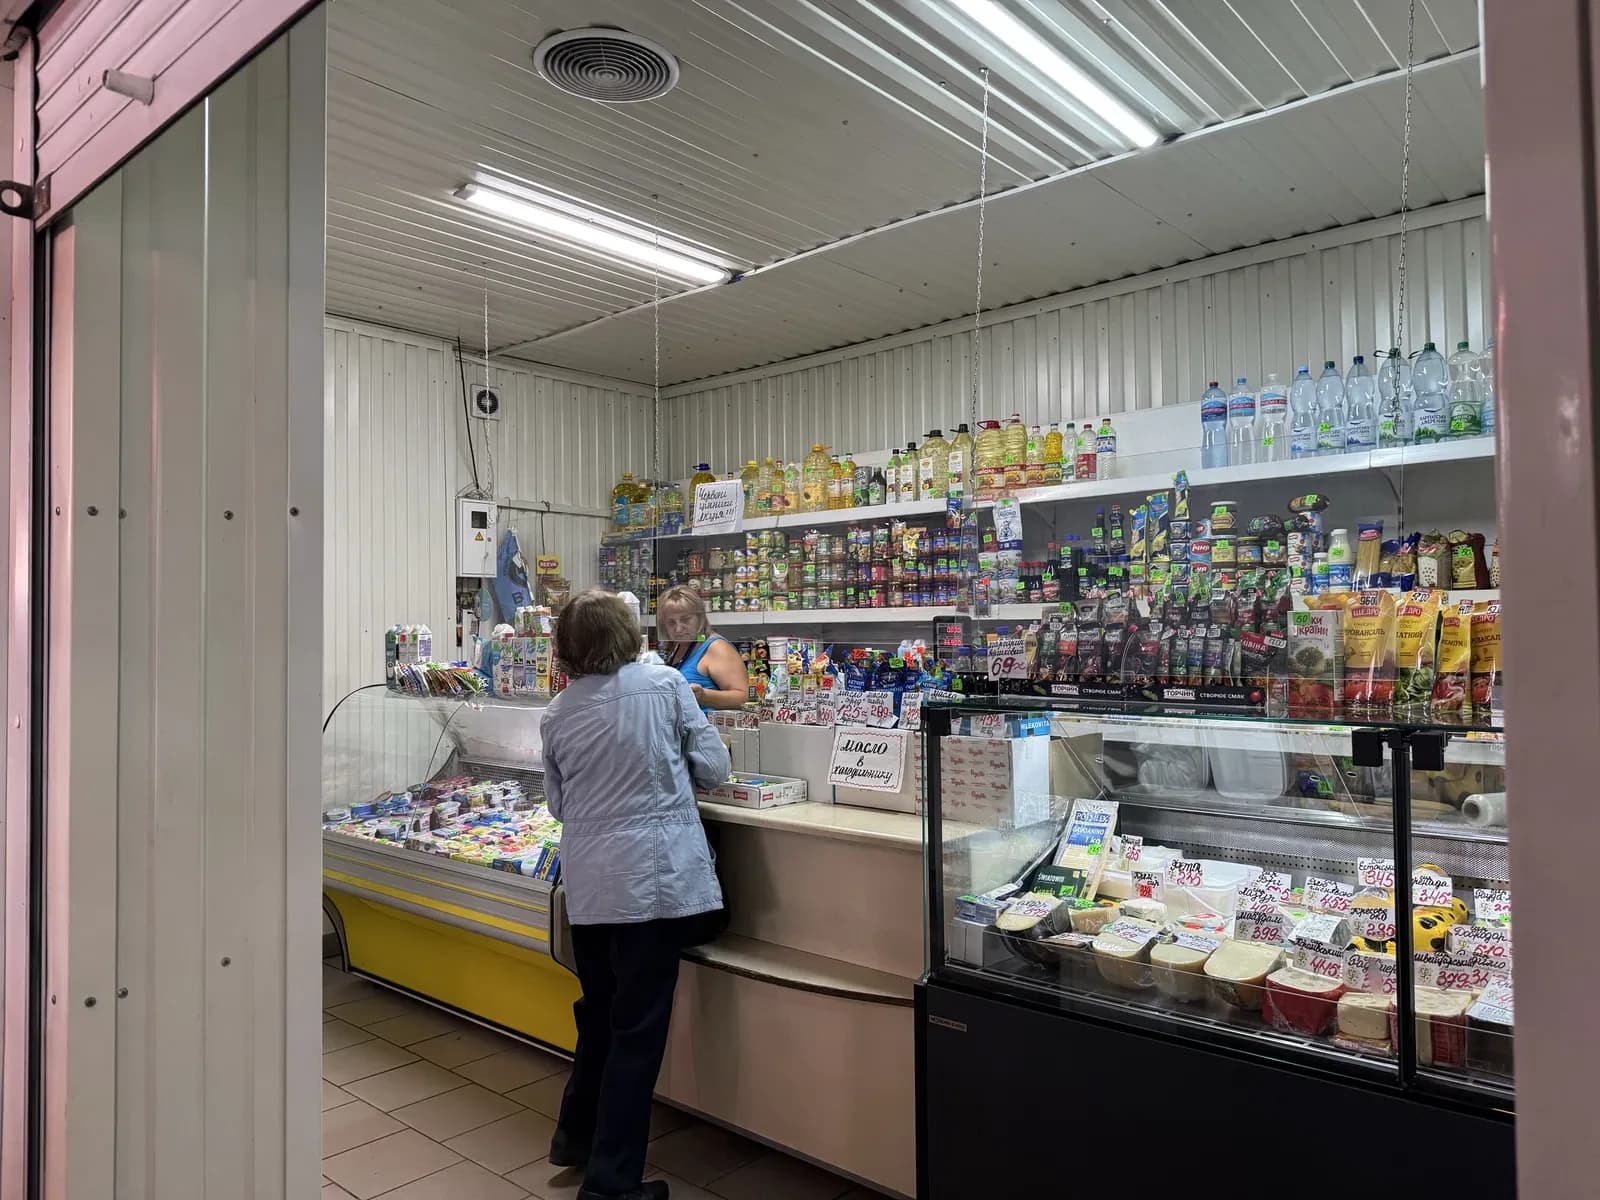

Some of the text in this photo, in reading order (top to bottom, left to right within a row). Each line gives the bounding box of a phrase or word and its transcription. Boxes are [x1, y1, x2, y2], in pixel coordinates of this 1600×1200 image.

[1353, 608, 1379, 616] ЩЕДРО
[1053, 685, 1078, 694] ТОРЧИН
[1166, 690, 1195, 698] ТОРЧИН
